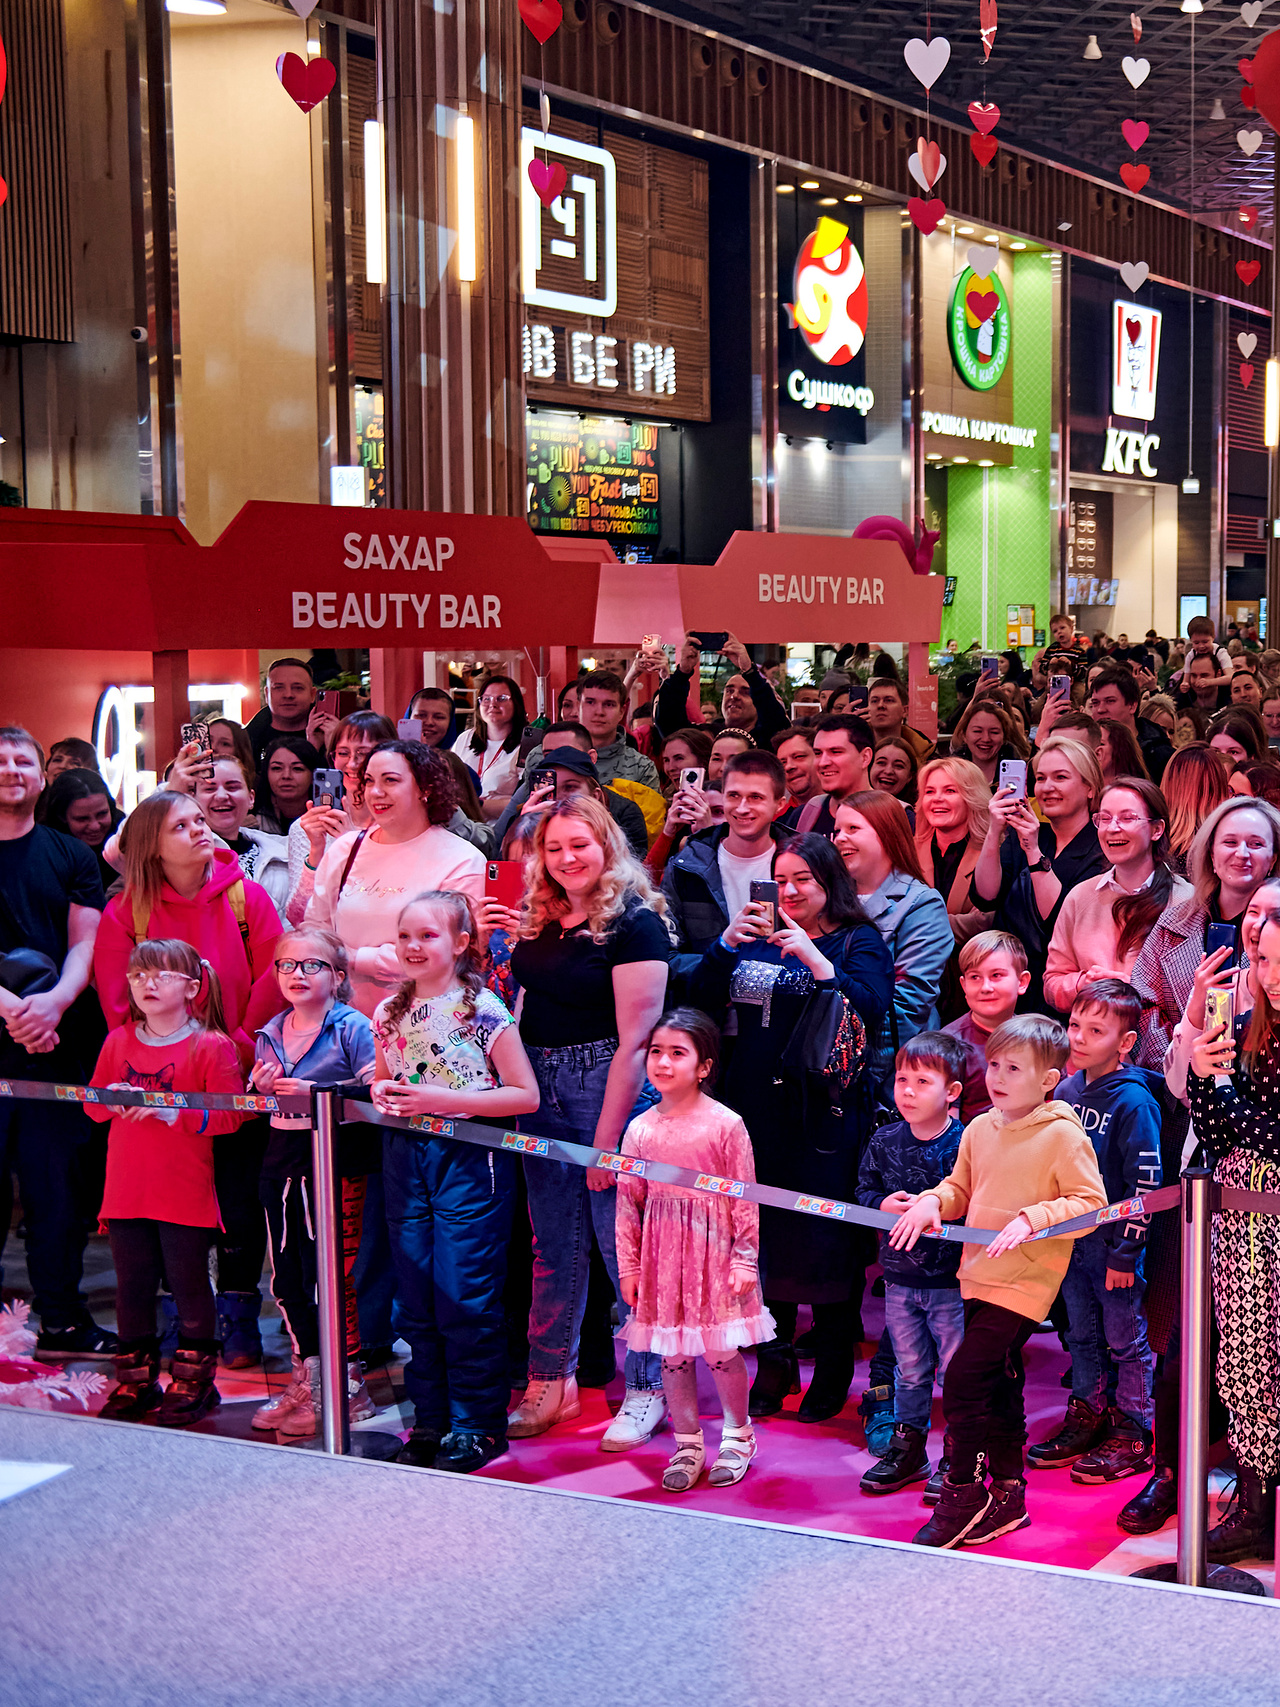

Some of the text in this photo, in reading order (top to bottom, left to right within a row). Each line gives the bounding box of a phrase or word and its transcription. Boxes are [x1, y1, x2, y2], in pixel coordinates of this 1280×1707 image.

[955, 306, 1008, 383] КРОШКА КАРТОШКА
[787, 368, 875, 417] Сушкоф
[1101, 427, 1160, 479] KFC
[291, 591, 502, 629] BEAUTY BAR
[758, 573, 884, 605] BEAUTY BAR
